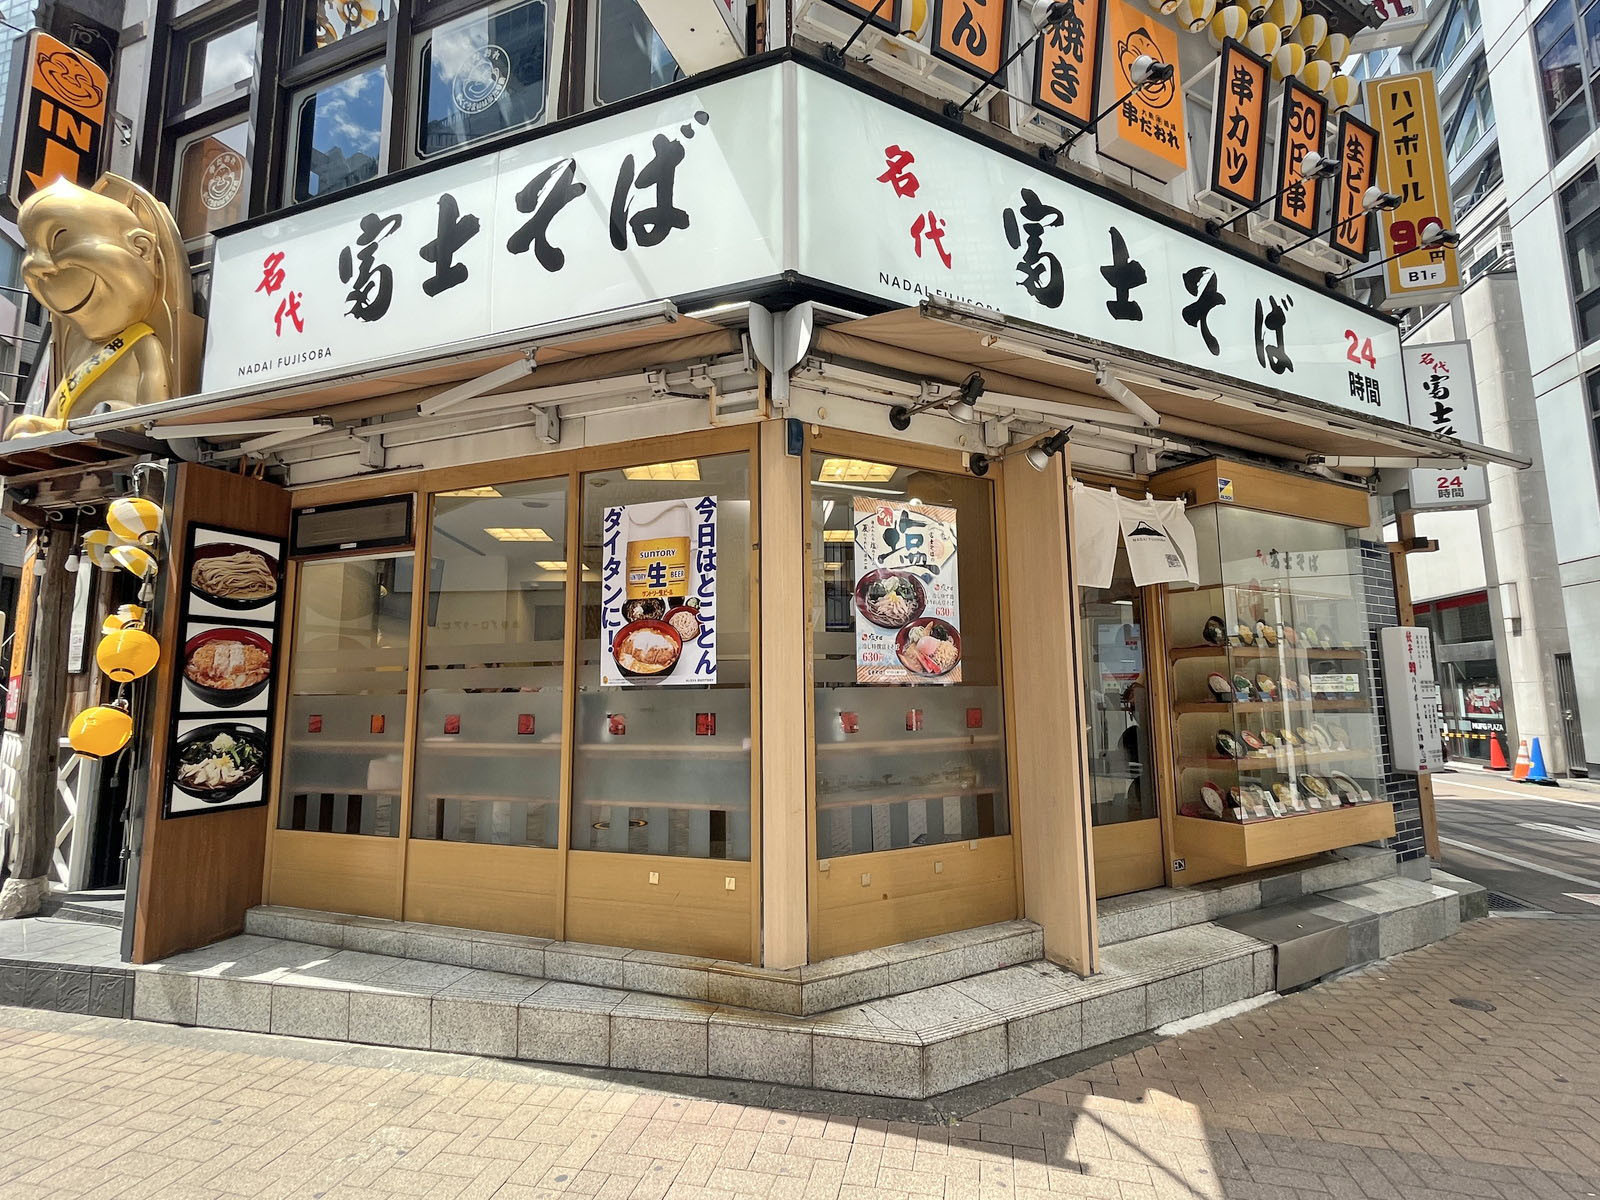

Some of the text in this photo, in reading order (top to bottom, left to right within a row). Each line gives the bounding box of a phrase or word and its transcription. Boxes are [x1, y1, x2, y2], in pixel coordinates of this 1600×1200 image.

[1048, 0, 1085, 104] 焼き
[38, 99, 92, 153] IN
[1122, 99, 1180, 150] 串だおれ
[1226, 64, 1255, 185] 串カツ
[1390, 90, 1425, 203] ハイボール
[1338, 133, 1365, 245] 生ビール
[254, 110, 710, 337] 名代 富士そば
[876, 144, 1295, 375] 名代 富士そば
[1408, 269, 1437, 282] B1F
[237, 345, 333, 377] NADAI FUJISOBA
[1344, 329, 1377, 370] 24
[1348, 370, 1381, 407] 時間
[1436, 475, 1463, 489] 24
[1437, 488, 1465, 499] 時間
[647, 561, 667, 588] 生
[670, 570, 684, 579] BEER
[694, 496, 718, 676] 今日はとことん
